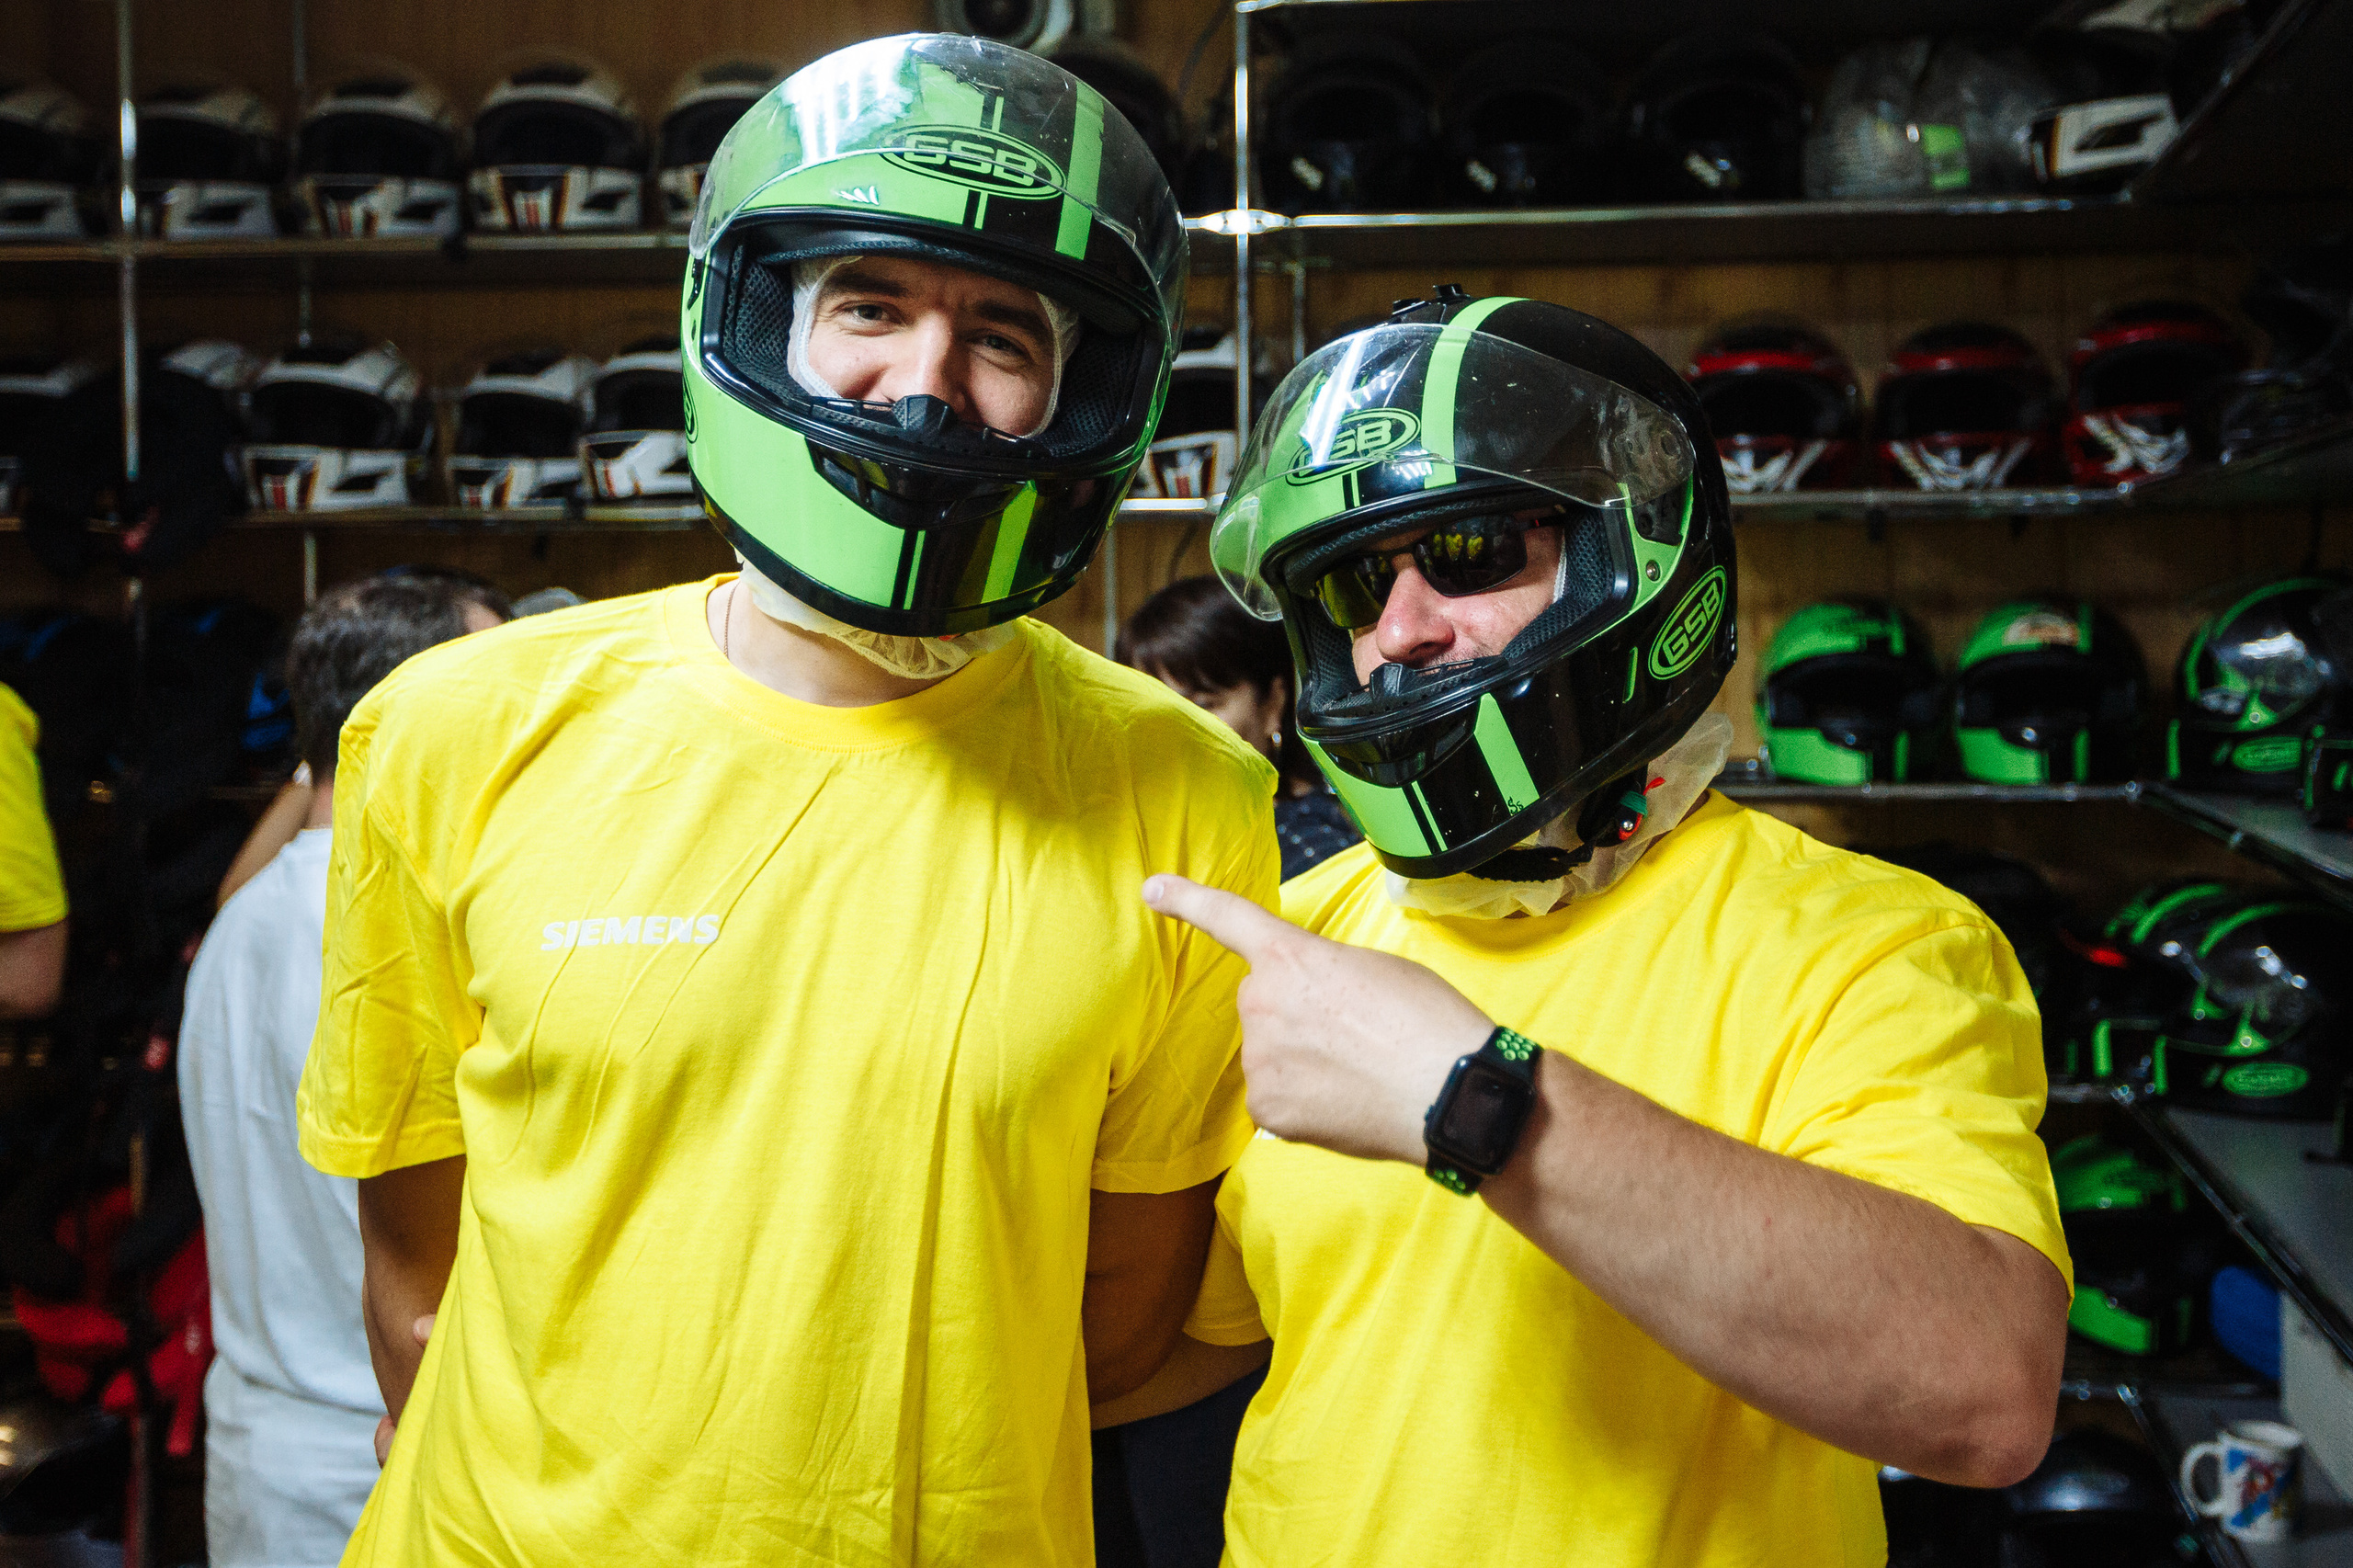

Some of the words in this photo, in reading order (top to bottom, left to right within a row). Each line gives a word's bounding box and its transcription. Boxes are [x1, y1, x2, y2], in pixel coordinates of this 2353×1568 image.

[903, 134, 1038, 187] GSB
[1662, 580, 1721, 665] GSB
[540, 915, 720, 950] SIEMENS
